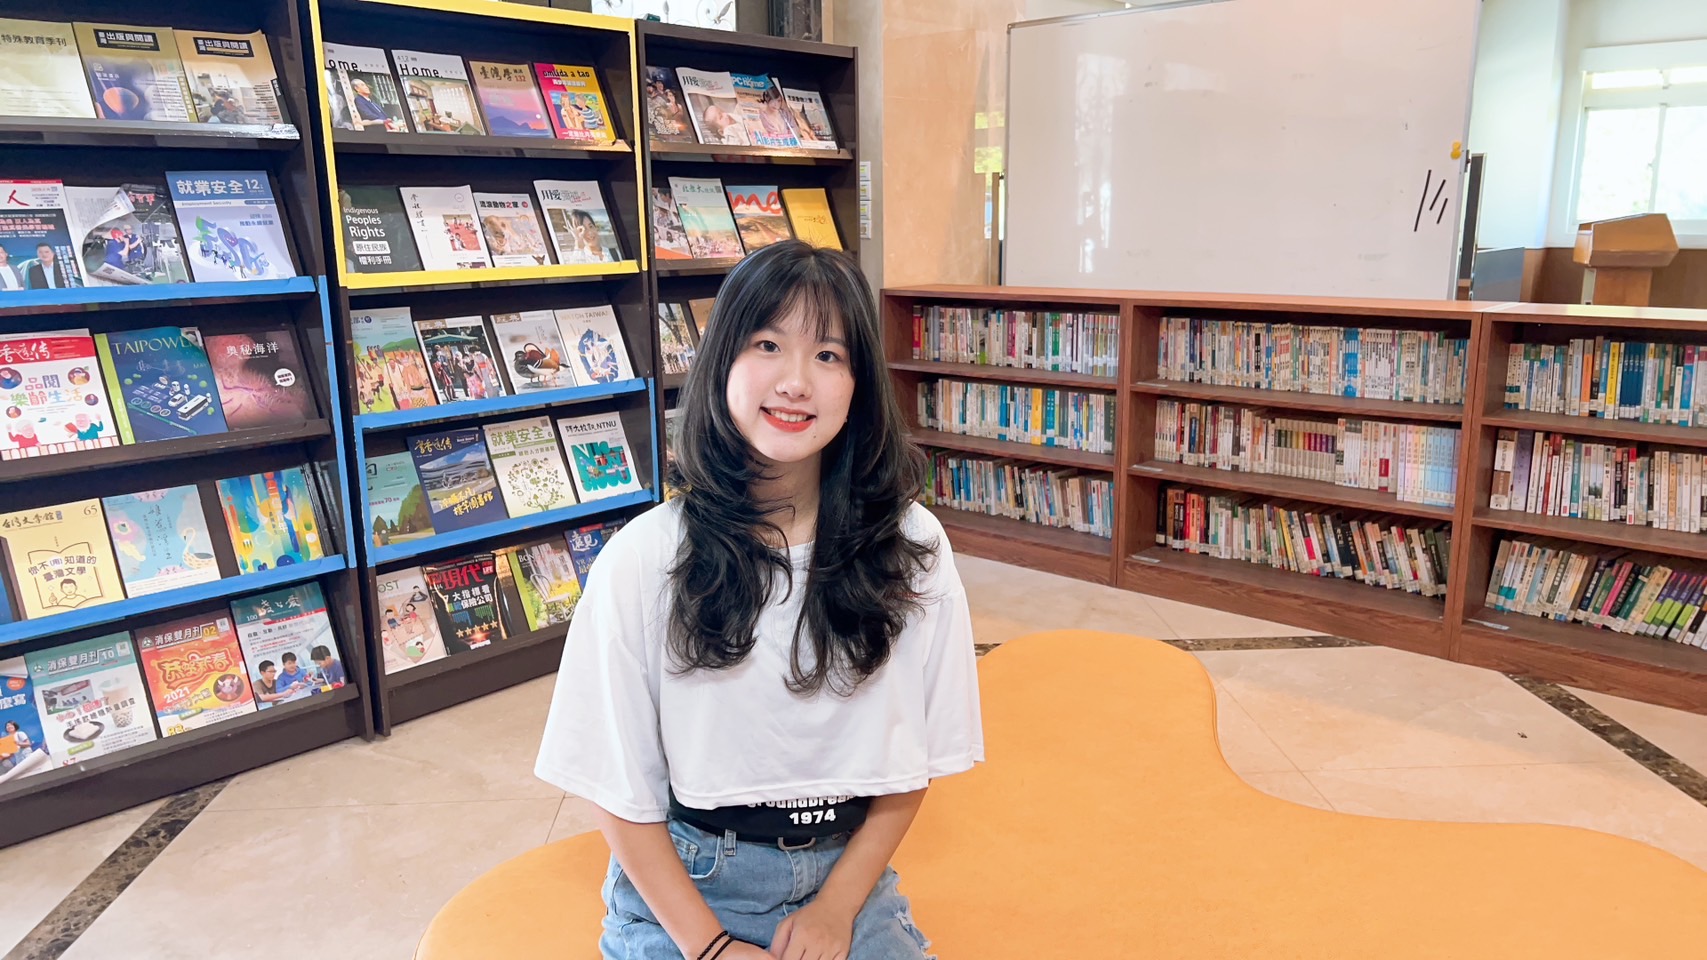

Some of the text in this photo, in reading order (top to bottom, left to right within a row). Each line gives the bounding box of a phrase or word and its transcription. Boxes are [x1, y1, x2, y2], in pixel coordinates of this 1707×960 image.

[176, 180, 245, 196] 就業安全
[343, 207, 379, 215] Indigenous
[346, 214, 382, 226] Peoples
[349, 226, 386, 240] Rights
[111, 336, 192, 355] TAIPOWE
[226, 341, 279, 356] 奧秘海洋
[490, 426, 545, 447] 就業安全
[83, 505, 98, 516] 65
[570, 530, 598, 552] 遠見
[461, 593, 493, 610] 保險公司
[155, 625, 217, 646] 消保雙月刊 02
[48, 650, 115, 671] 消保雙月刊 10
[164, 687, 191, 703] 2021
[789, 809, 836, 825] 1974
